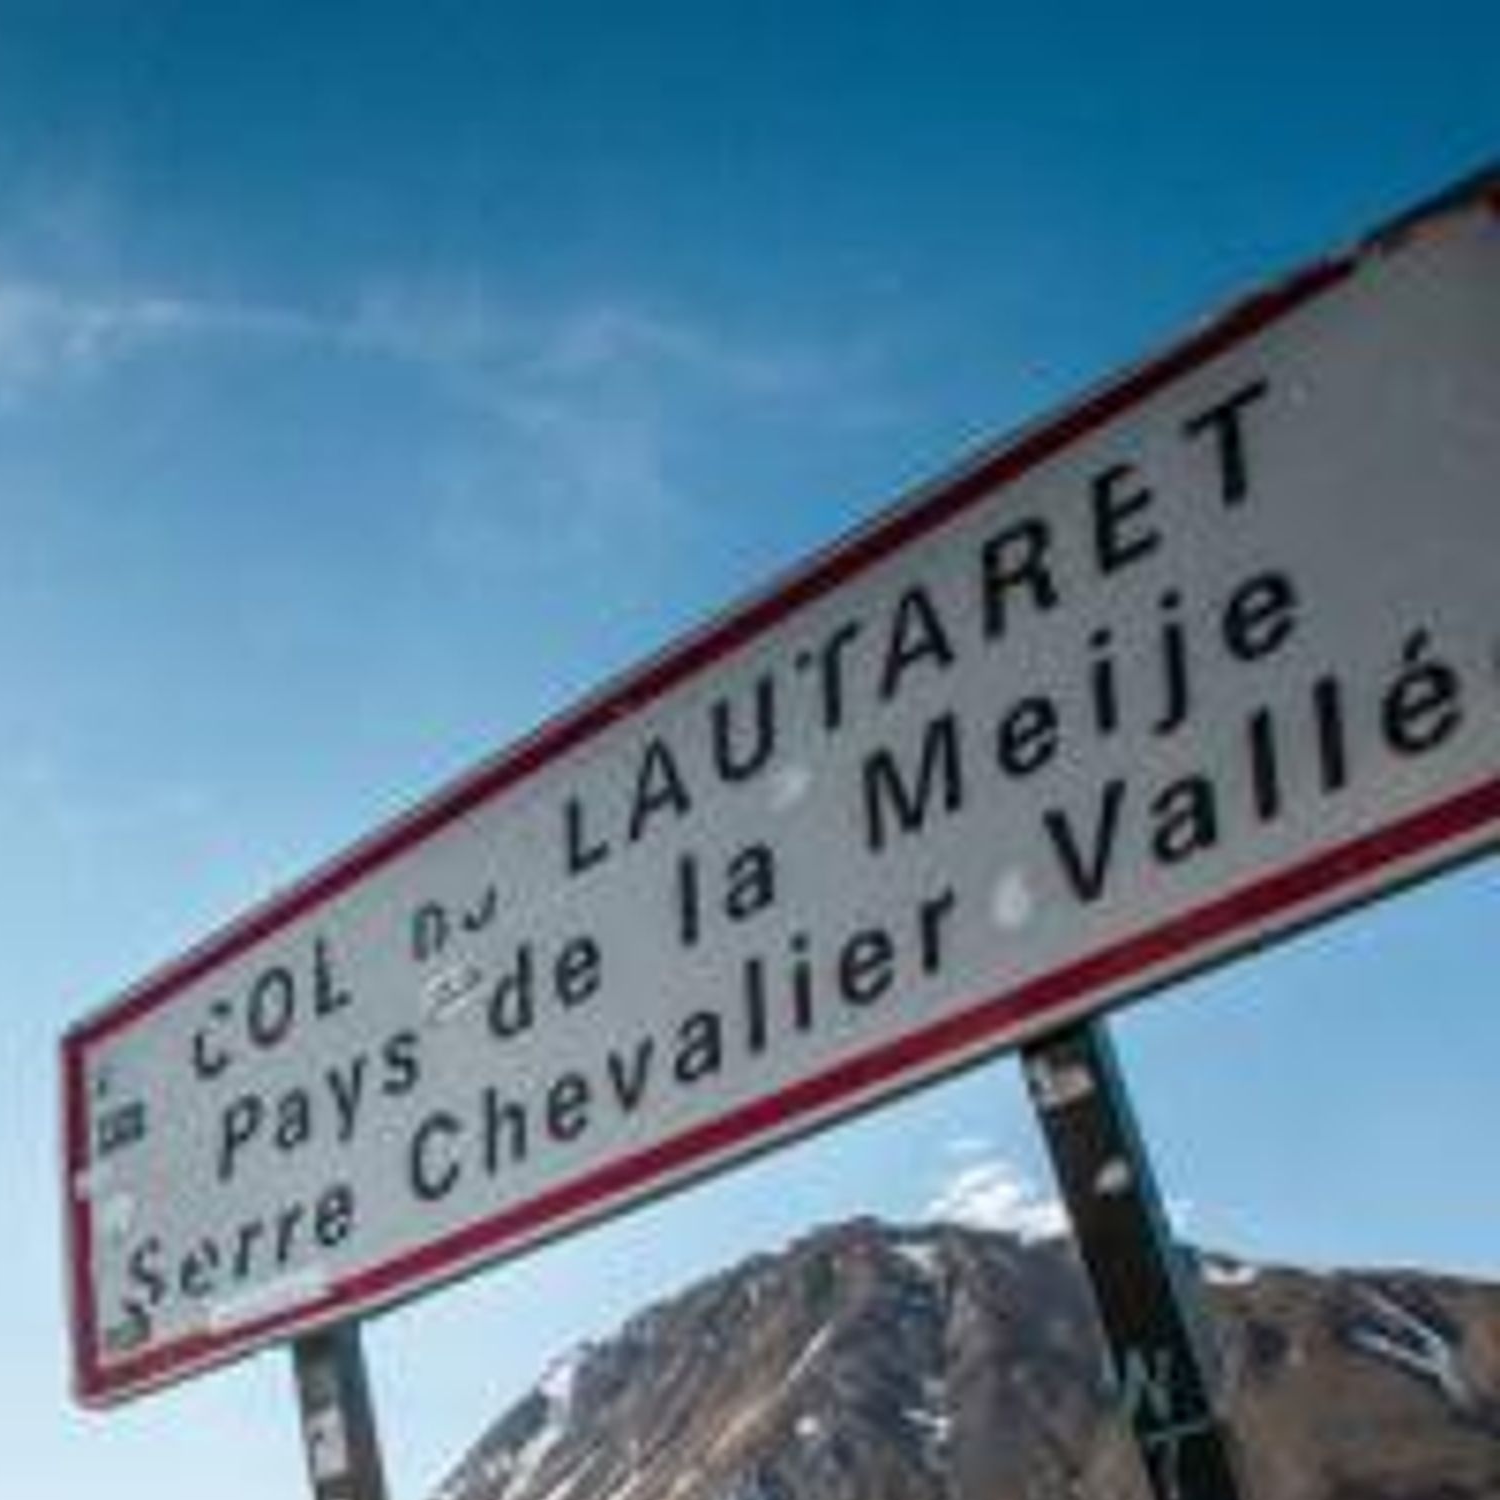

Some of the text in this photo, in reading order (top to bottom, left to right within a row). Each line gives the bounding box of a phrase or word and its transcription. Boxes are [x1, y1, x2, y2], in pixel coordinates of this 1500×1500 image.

[122, 625, 1500, 1320] Serre Chevalier Vallé
[191, 936, 352, 1080] COL
[561, 379, 1268, 874] LAUTARET
[488, 936, 601, 1037] de
[680, 842, 776, 946] la
[860, 568, 1296, 852] Meije
